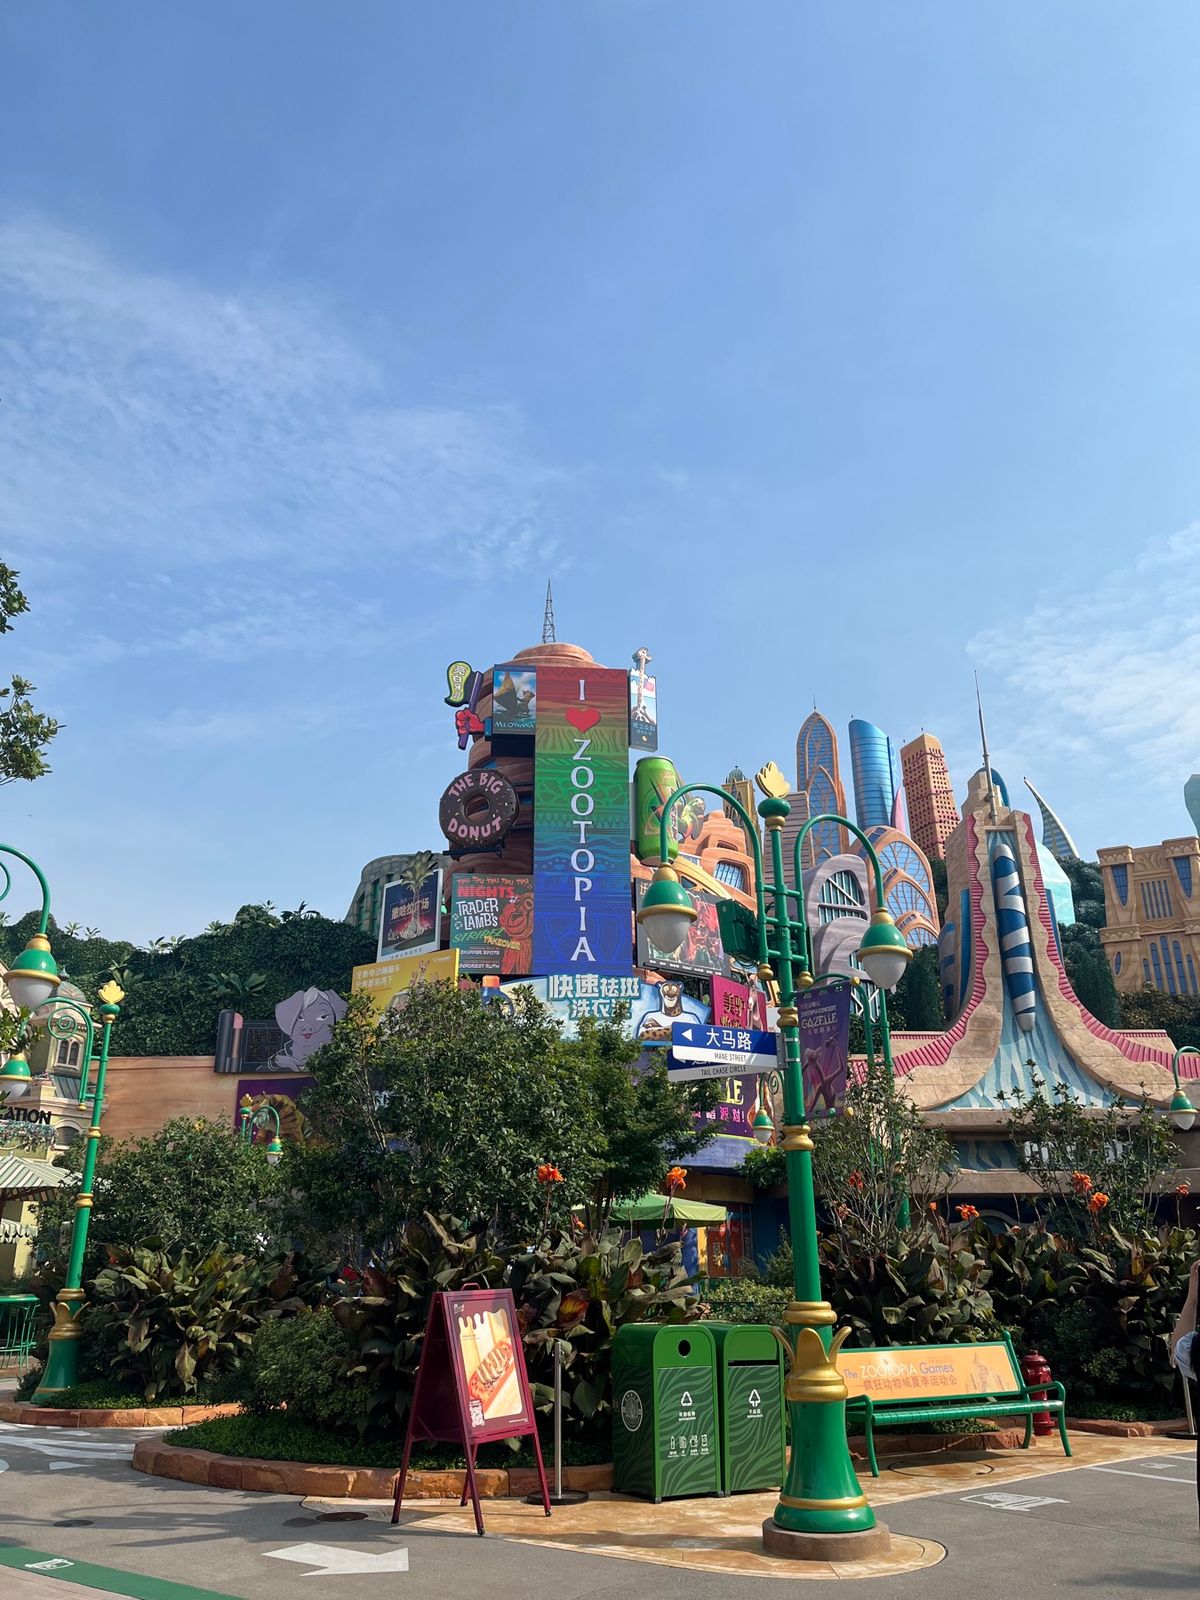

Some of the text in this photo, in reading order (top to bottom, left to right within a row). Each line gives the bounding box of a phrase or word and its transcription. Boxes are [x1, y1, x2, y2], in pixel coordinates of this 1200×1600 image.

[448, 772, 504, 797] THE BIG
[447, 816, 502, 838] DONUT
[570, 679, 597, 962] I ZOOTOPIA
[457, 886, 514, 898] NIGHTS
[456, 897, 499, 916] TRADER
[483, 935, 521, 950] TAKEOVER
[549, 973, 640, 999] 快速祛斑
[801, 1012, 838, 1029] GAZELLE
[706, 1028, 753, 1051] 大马路
[714, 1052, 746, 1062] MANE STREET
[701, 1065, 747, 1077] TAIL CHASE CIRCLE
[844, 1362, 954, 1379] The ZOOTOPIA Games
